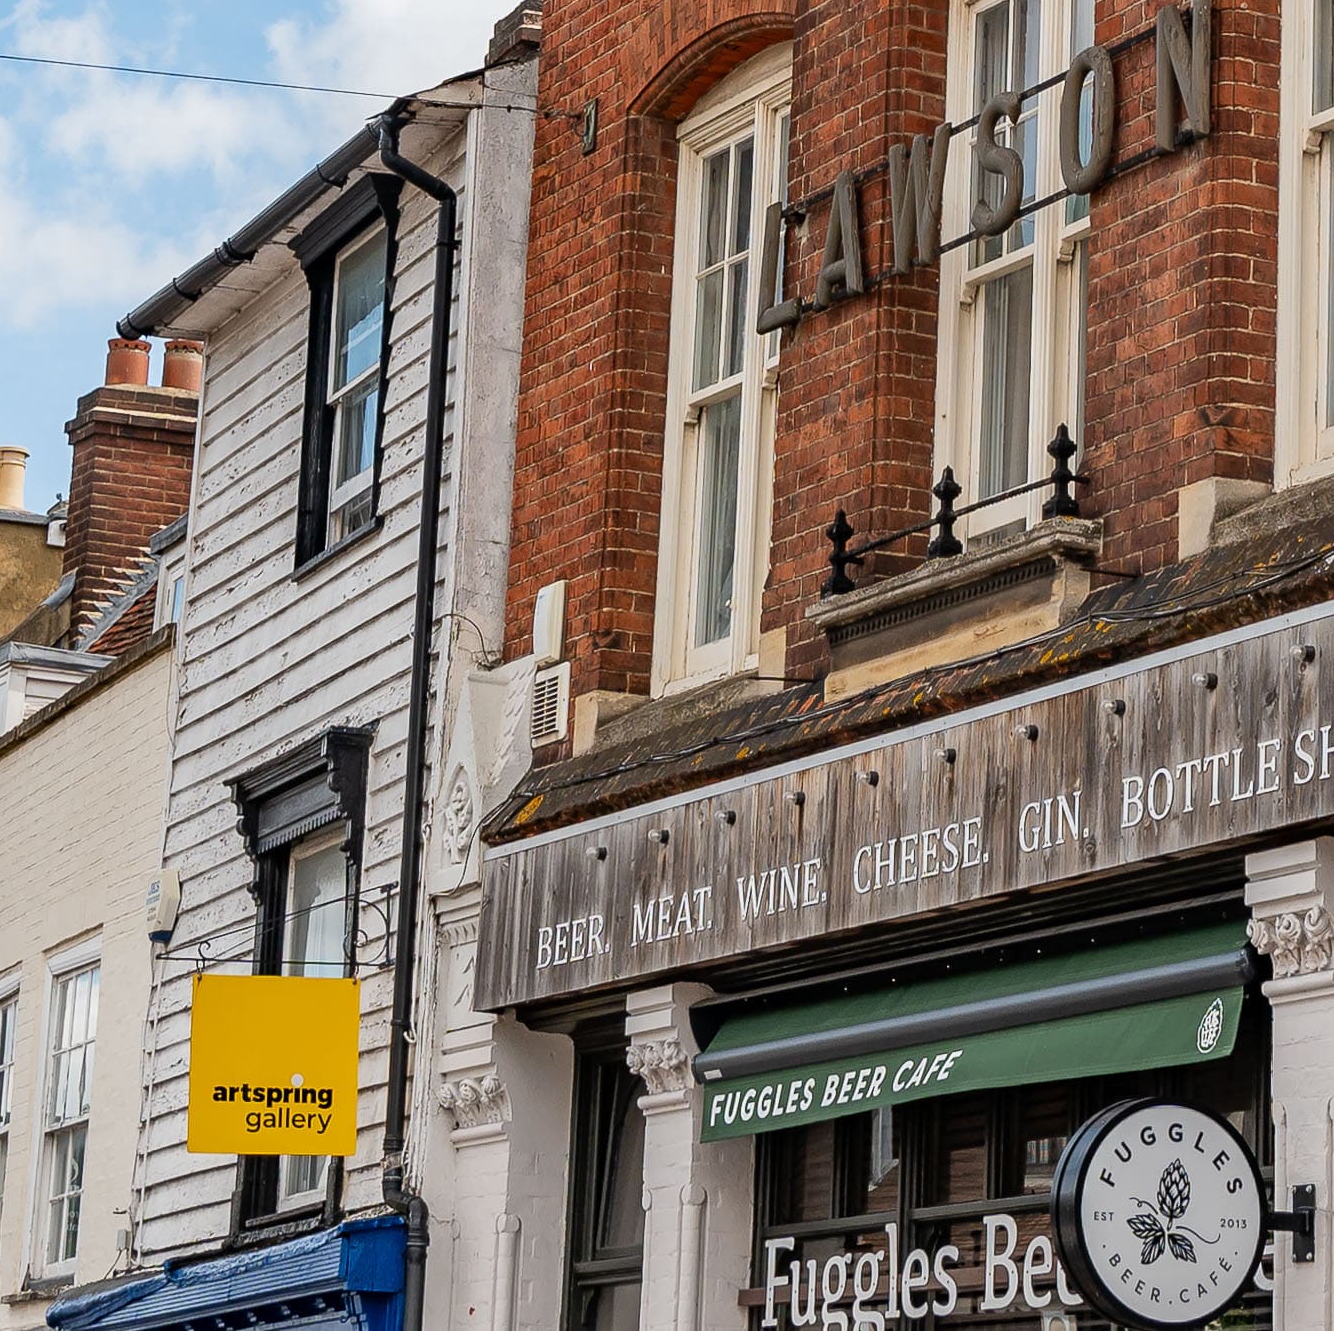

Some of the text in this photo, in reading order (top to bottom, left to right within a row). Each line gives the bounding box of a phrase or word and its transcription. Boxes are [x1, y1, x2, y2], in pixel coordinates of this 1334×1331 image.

[535, 914, 611, 970] BEER.
[630, 885, 714, 948] MEAT.
[736, 858, 827, 922] WINE.
[853, 816, 990, 895] CHEESE.
[1018, 790, 1089, 853] GIN.
[1120, 738, 1282, 830] BOTTLE
[212, 1074, 333, 1109] artspring
[710, 1049, 963, 1127] FUGGLES BEER CAFE
[245, 1107, 332, 1134] gallery
[1099, 1123, 1243, 1194] FUGGLES
[1093, 1211, 1247, 1229] EST 2013
[761, 1222, 959, 1331] Fuggles
[1108, 1253, 1161, 1303] BEER
